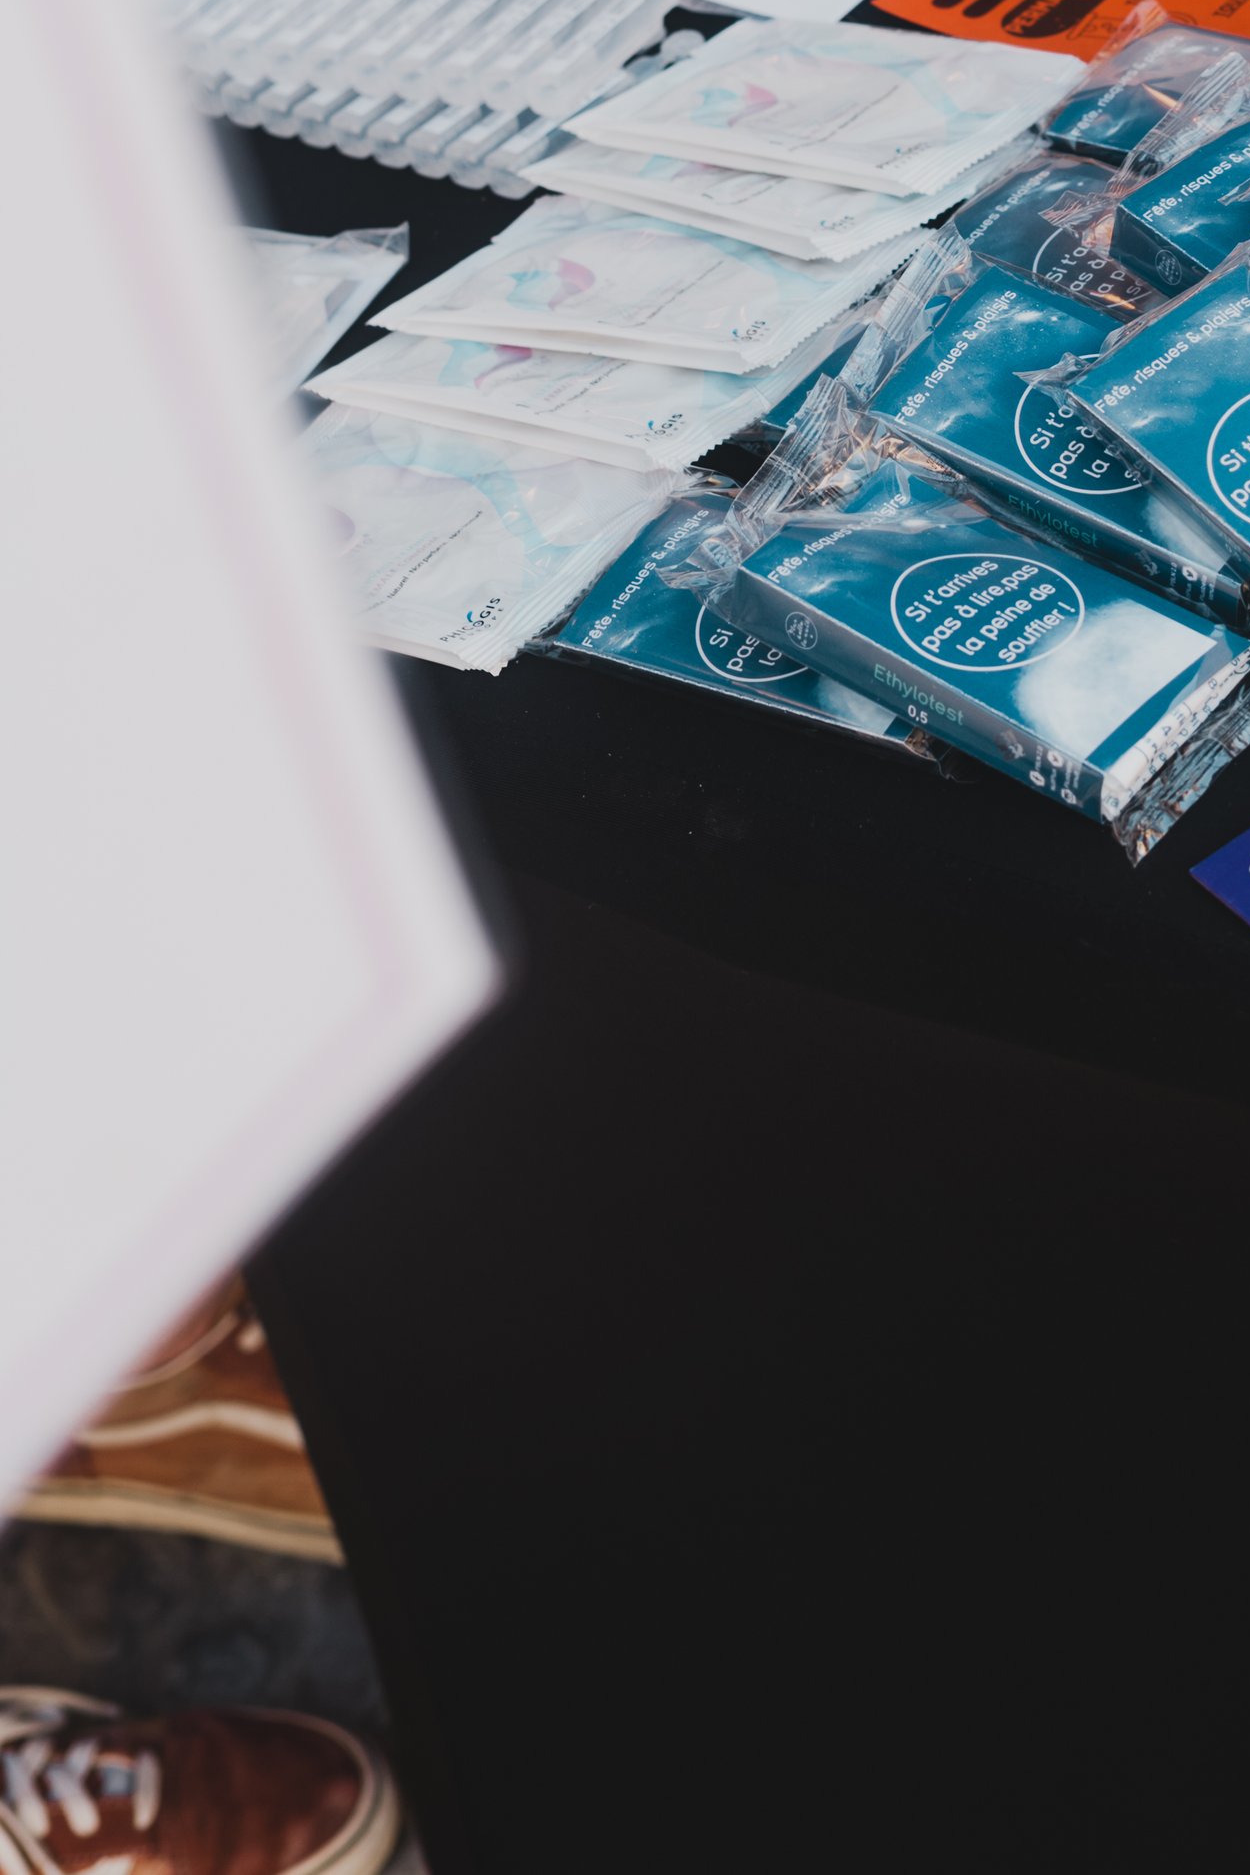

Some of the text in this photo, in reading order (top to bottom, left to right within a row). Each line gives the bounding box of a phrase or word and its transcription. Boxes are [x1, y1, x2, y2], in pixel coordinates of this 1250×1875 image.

[1143, 195, 1182, 223] Fête,
[1180, 160, 1232, 197] risques
[1228, 153, 1244, 163] &
[1046, 264, 1065, 282] Si
[1070, 272, 1093, 292] as
[894, 288, 1017, 425] Fête, risques & plaisirs
[1094, 382, 1136, 414] Fête,
[1134, 340, 1189, 383] risques
[1185, 332, 1201, 344] &
[1030, 427, 1056, 449] Si
[1049, 440, 1084, 479] pas
[1219, 449, 1245, 473] Si
[1083, 459, 1110, 478] la
[1008, 494, 1100, 547] Ethylotest
[582, 509, 709, 648] Fête, risques & plaisirs
[767, 526, 852, 583] Fête, risques
[904, 559, 999, 623] Si t'arrives
[709, 628, 733, 648] Si
[921, 621, 962, 653] pas
[954, 604, 977, 618] à
[956, 583, 1056, 656] la peine de
[998, 610, 1066, 662] souffler
[727, 637, 759, 672] pas
[873, 664, 965, 726] Ethylotest
[908, 705, 928, 724] 0,5
